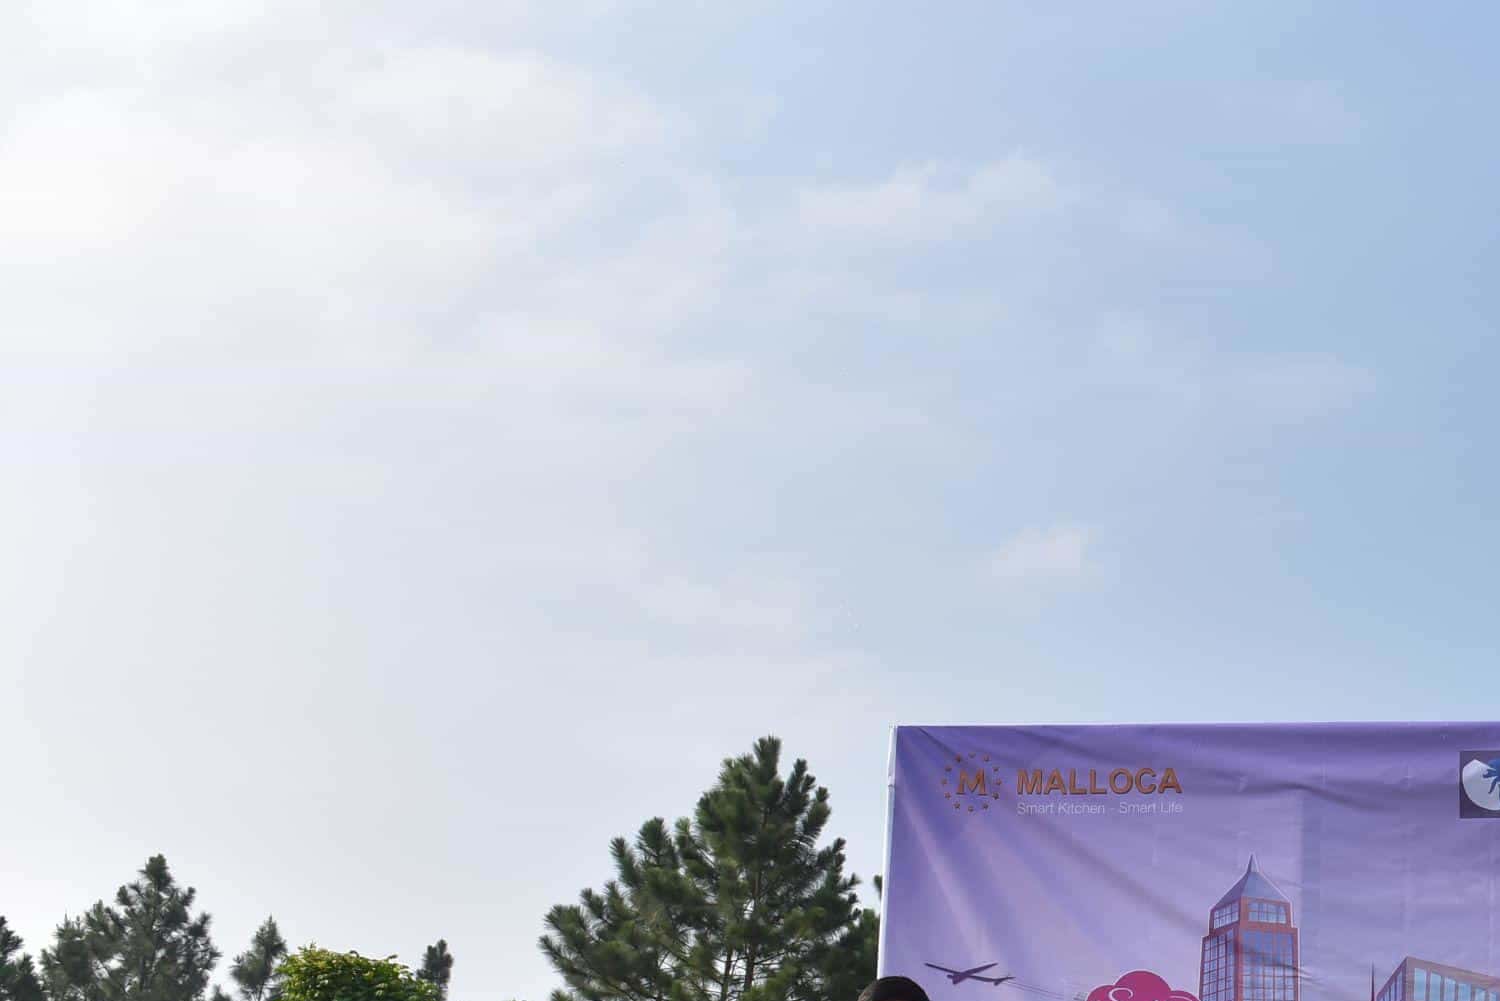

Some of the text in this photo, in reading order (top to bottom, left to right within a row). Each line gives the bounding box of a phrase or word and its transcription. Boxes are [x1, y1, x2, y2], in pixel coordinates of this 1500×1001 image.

[956, 767, 987, 796] M
[1016, 767, 1183, 796] MALLOCA
[1016, 802, 1055, 816] Smart
[1058, 803, 1105, 816] Kitchen
[1119, 801, 1157, 815] Smart
[1160, 801, 1183, 814] Life
